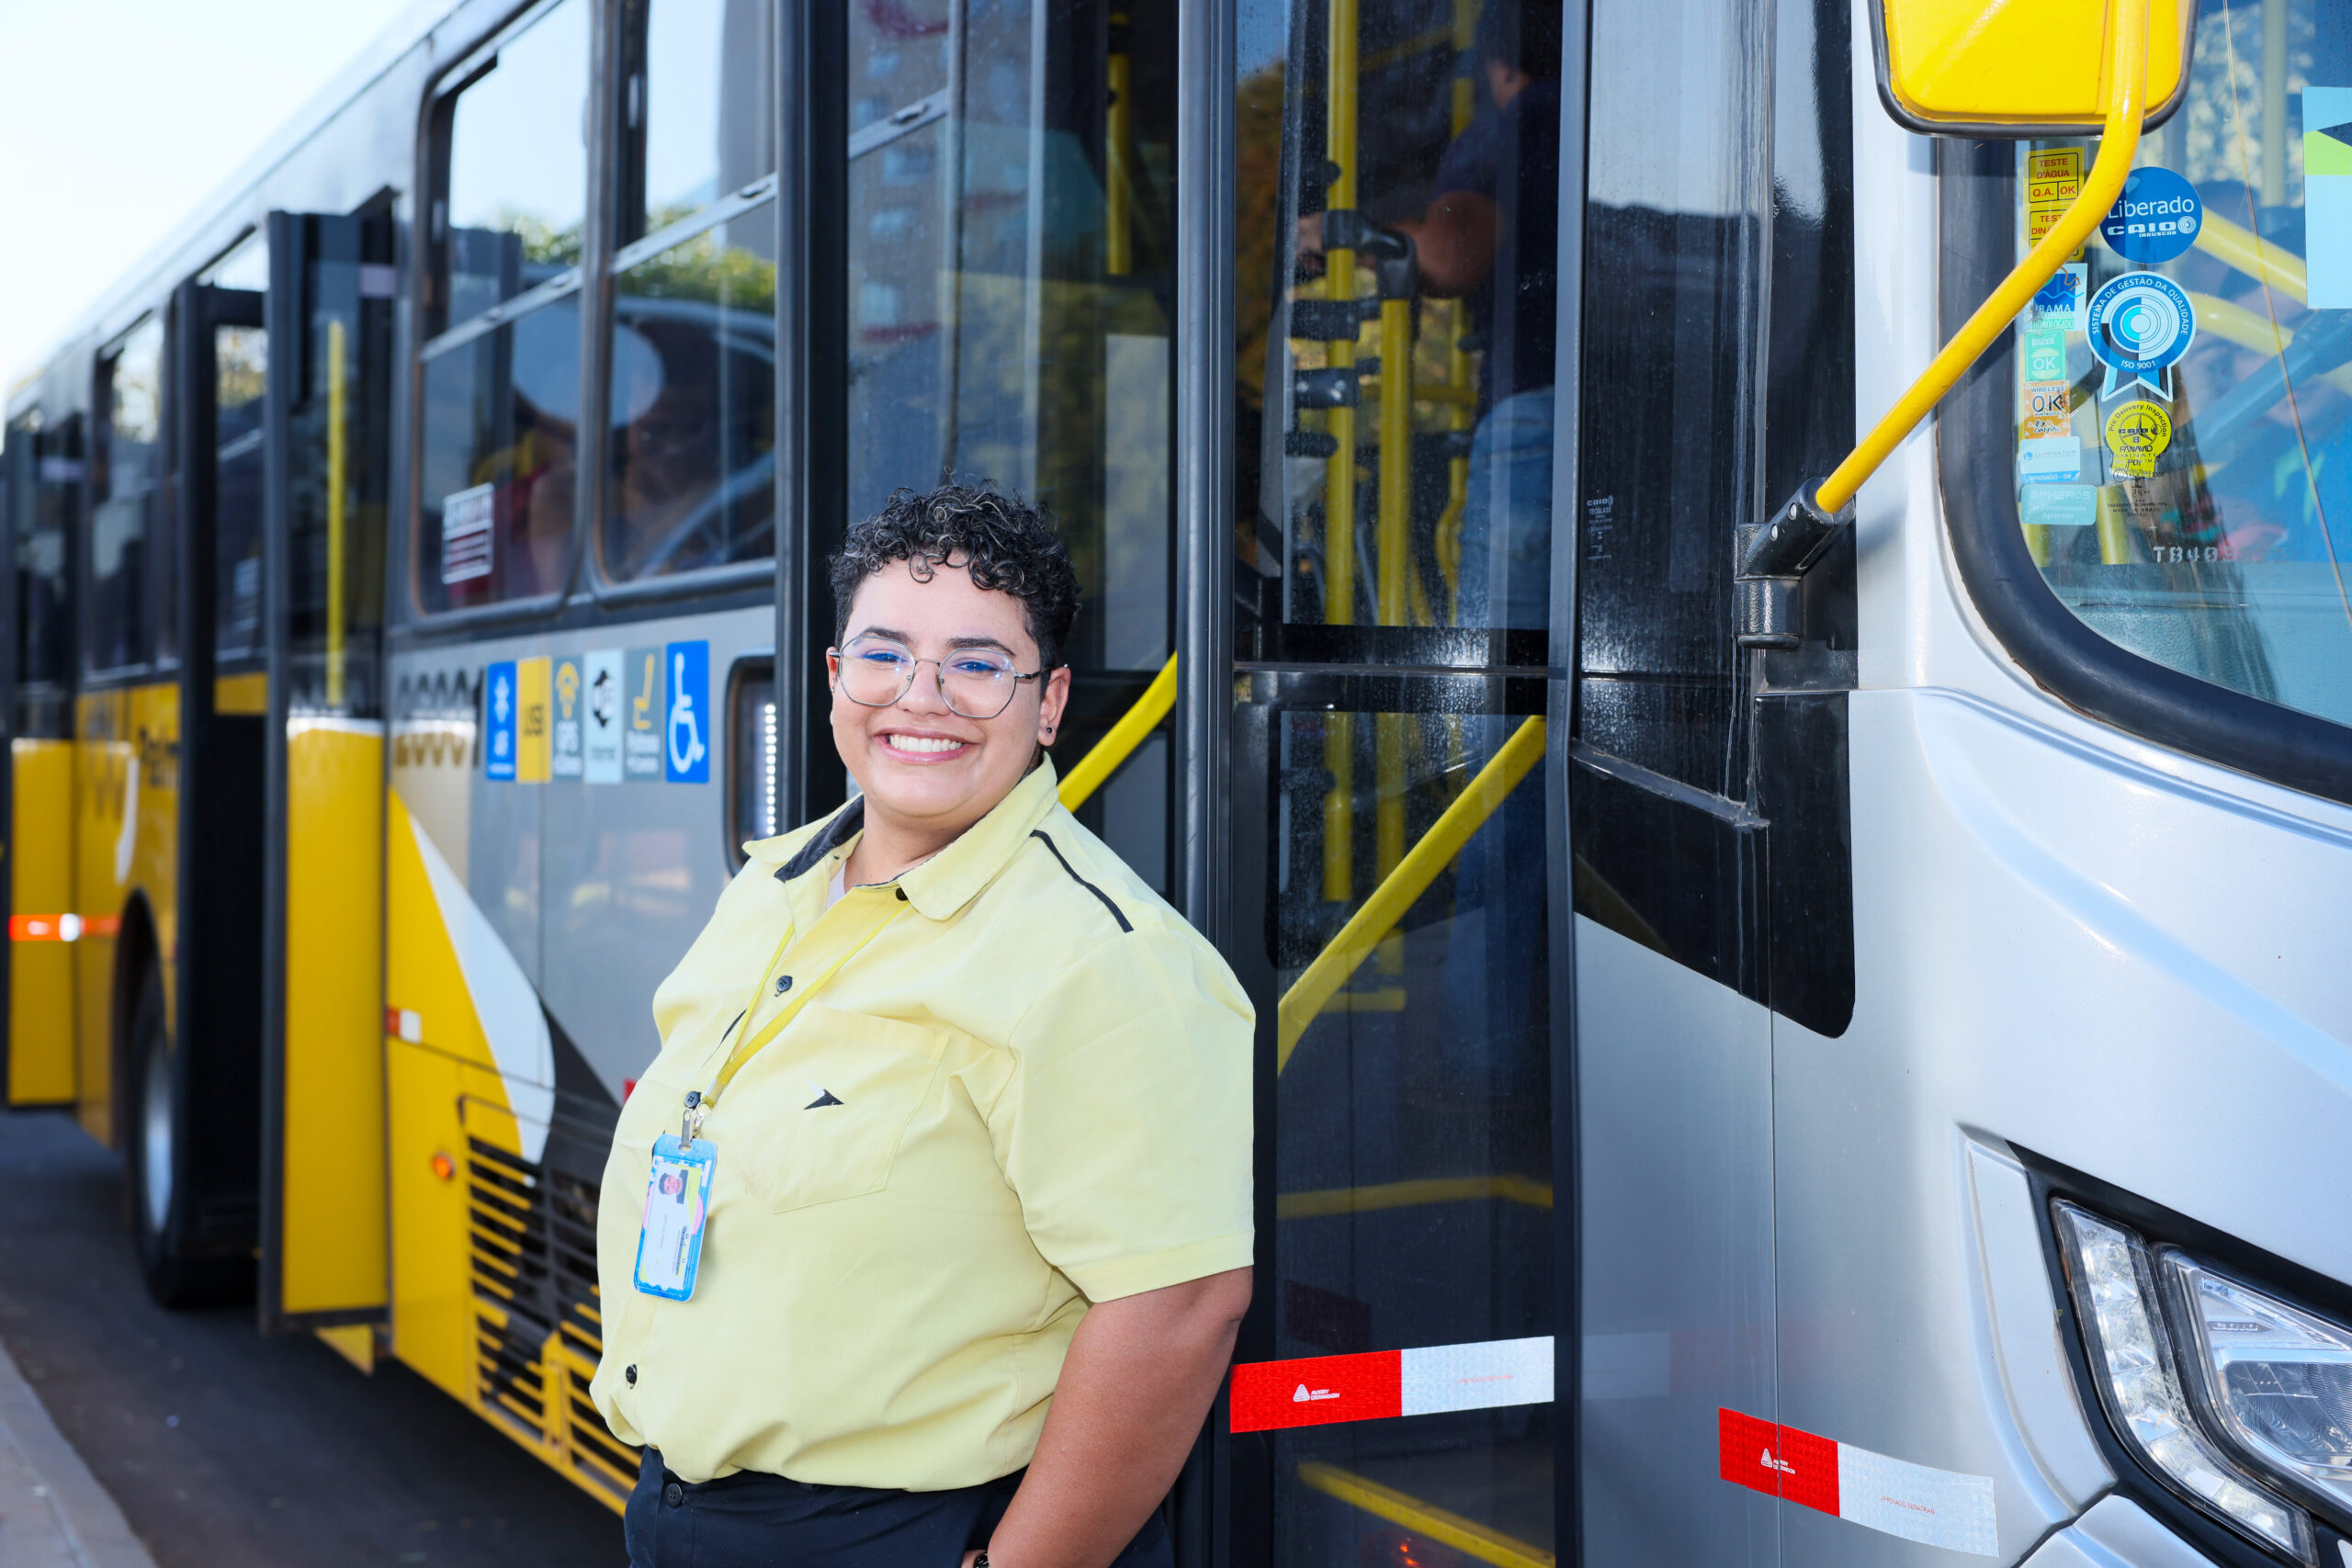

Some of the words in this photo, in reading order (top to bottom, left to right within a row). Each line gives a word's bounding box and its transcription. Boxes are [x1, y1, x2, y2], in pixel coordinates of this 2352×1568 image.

[2039, 158, 2068, 168] TESTE
[2032, 187, 2055, 197] Q.A.
[2060, 186, 2075, 195] OK
[2108, 195, 2195, 220] Liberado
[2039, 214, 2064, 223] TEST
[2107, 221, 2177, 236] CAIO
[2091, 299, 2108, 334] SISTEMA
[2104, 287, 2117, 299] DE
[2117, 276, 2154, 290] GESTÃO
[2154, 280, 2168, 292] DA
[2167, 288, 2190, 336] QUALIDADE
[2032, 356, 2057, 370] OK
[2120, 359, 2135, 369] ISO
[2136, 359, 2156, 369] 9001
[2030, 386, 2066, 394] WIRELESS
[2031, 394, 2064, 412] OK
[2109, 419, 2117, 432] Pre
[2114, 404, 2144, 420] Delivery
[2145, 404, 2167, 437] Inspection
[2030, 491, 2091, 501] SPHEROS
